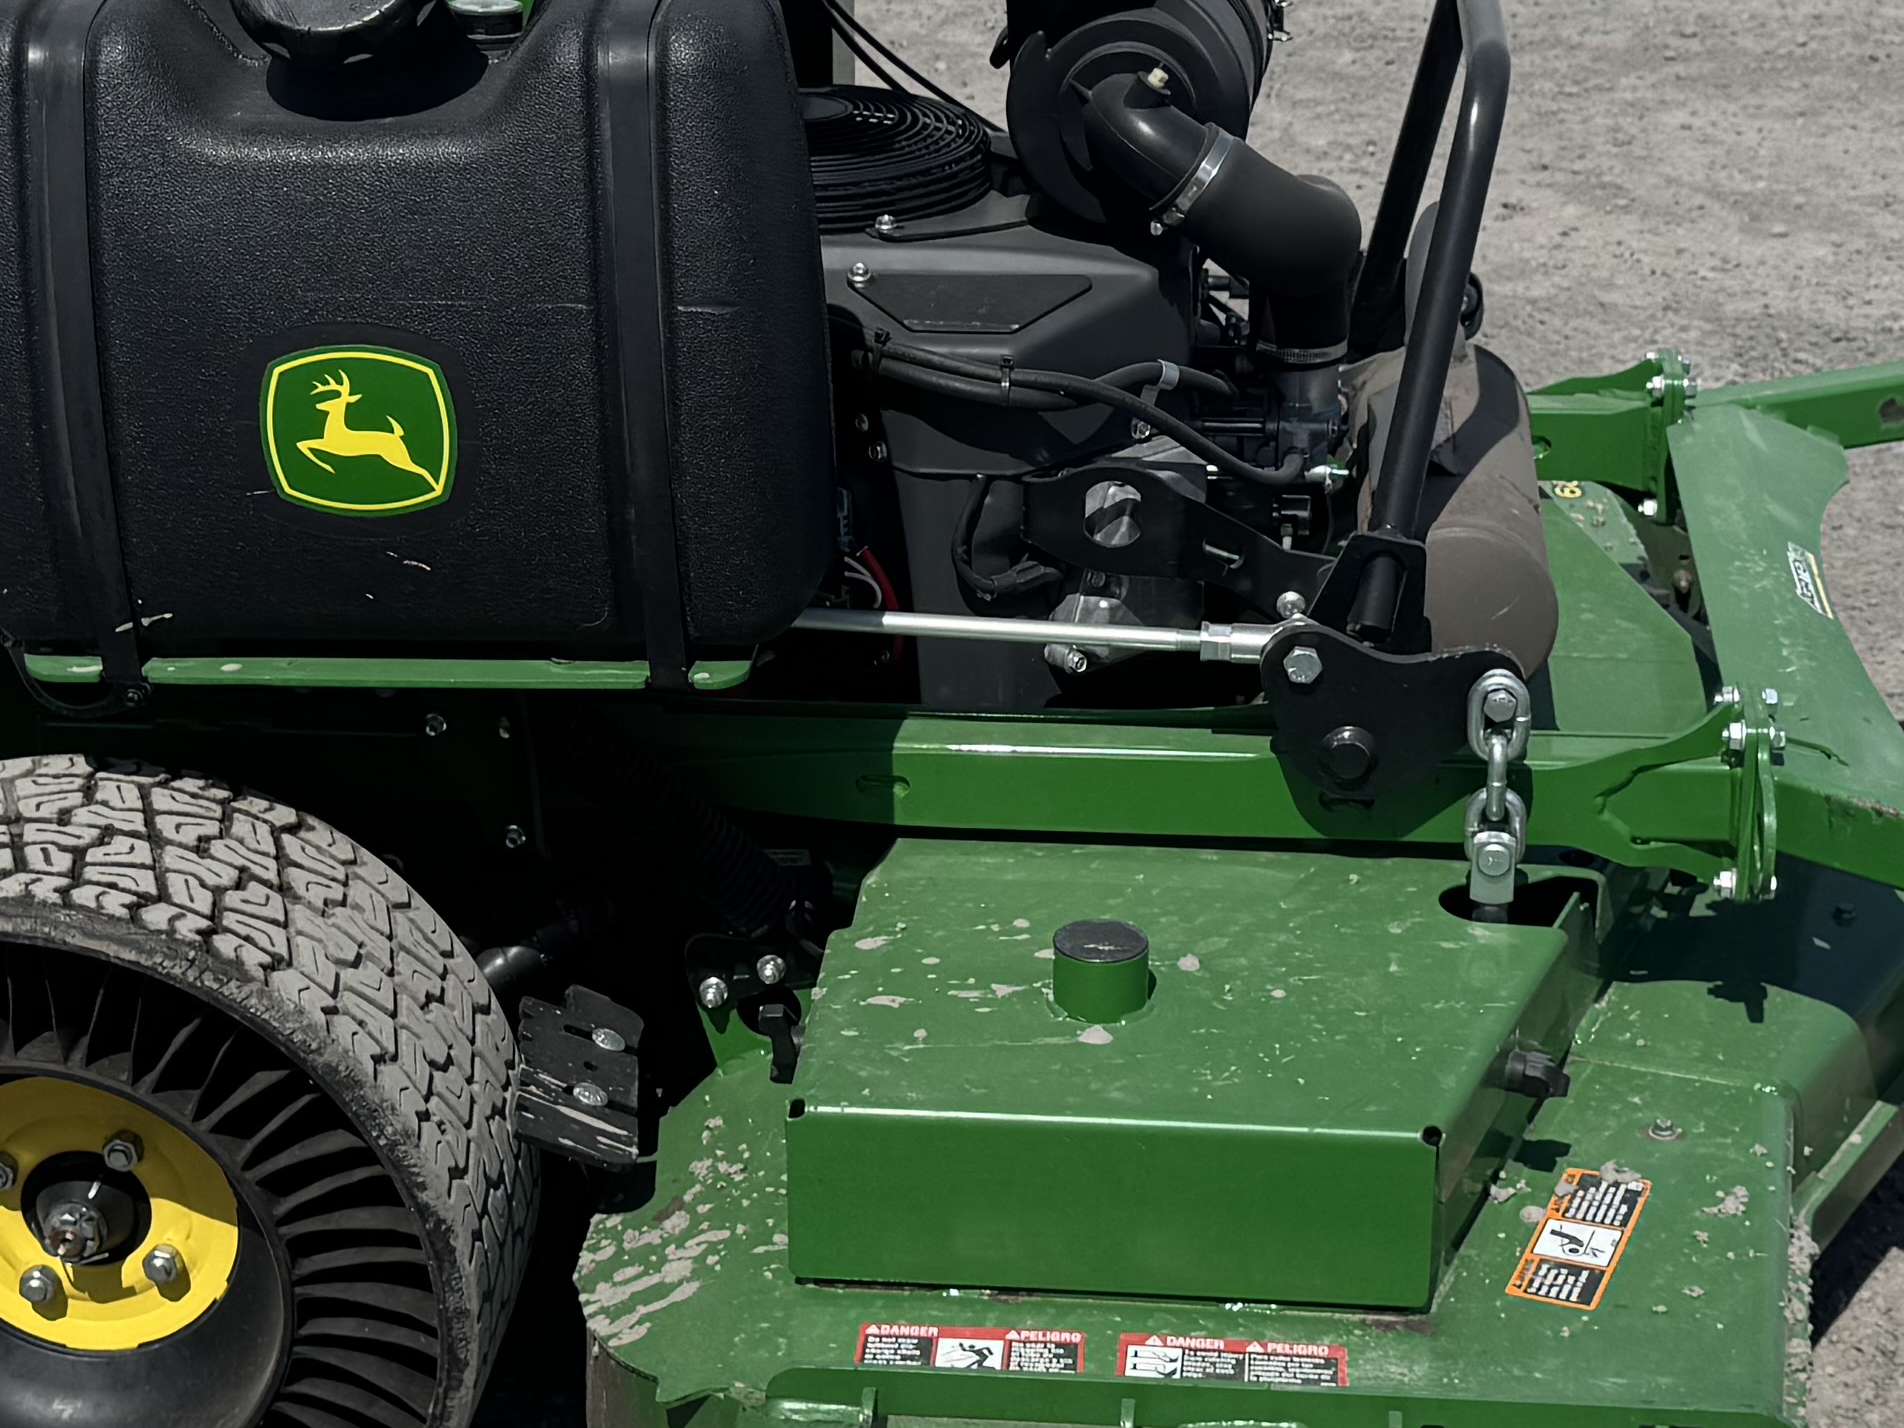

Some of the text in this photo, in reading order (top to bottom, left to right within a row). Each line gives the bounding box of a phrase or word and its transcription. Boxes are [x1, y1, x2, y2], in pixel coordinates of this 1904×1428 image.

[880, 1325, 939, 1337] DANGER
[1020, 1331, 1082, 1343] PELIGRO
[1166, 1336, 1225, 1349] DANGER
[1267, 1343, 1329, 1356] PELIGRO
